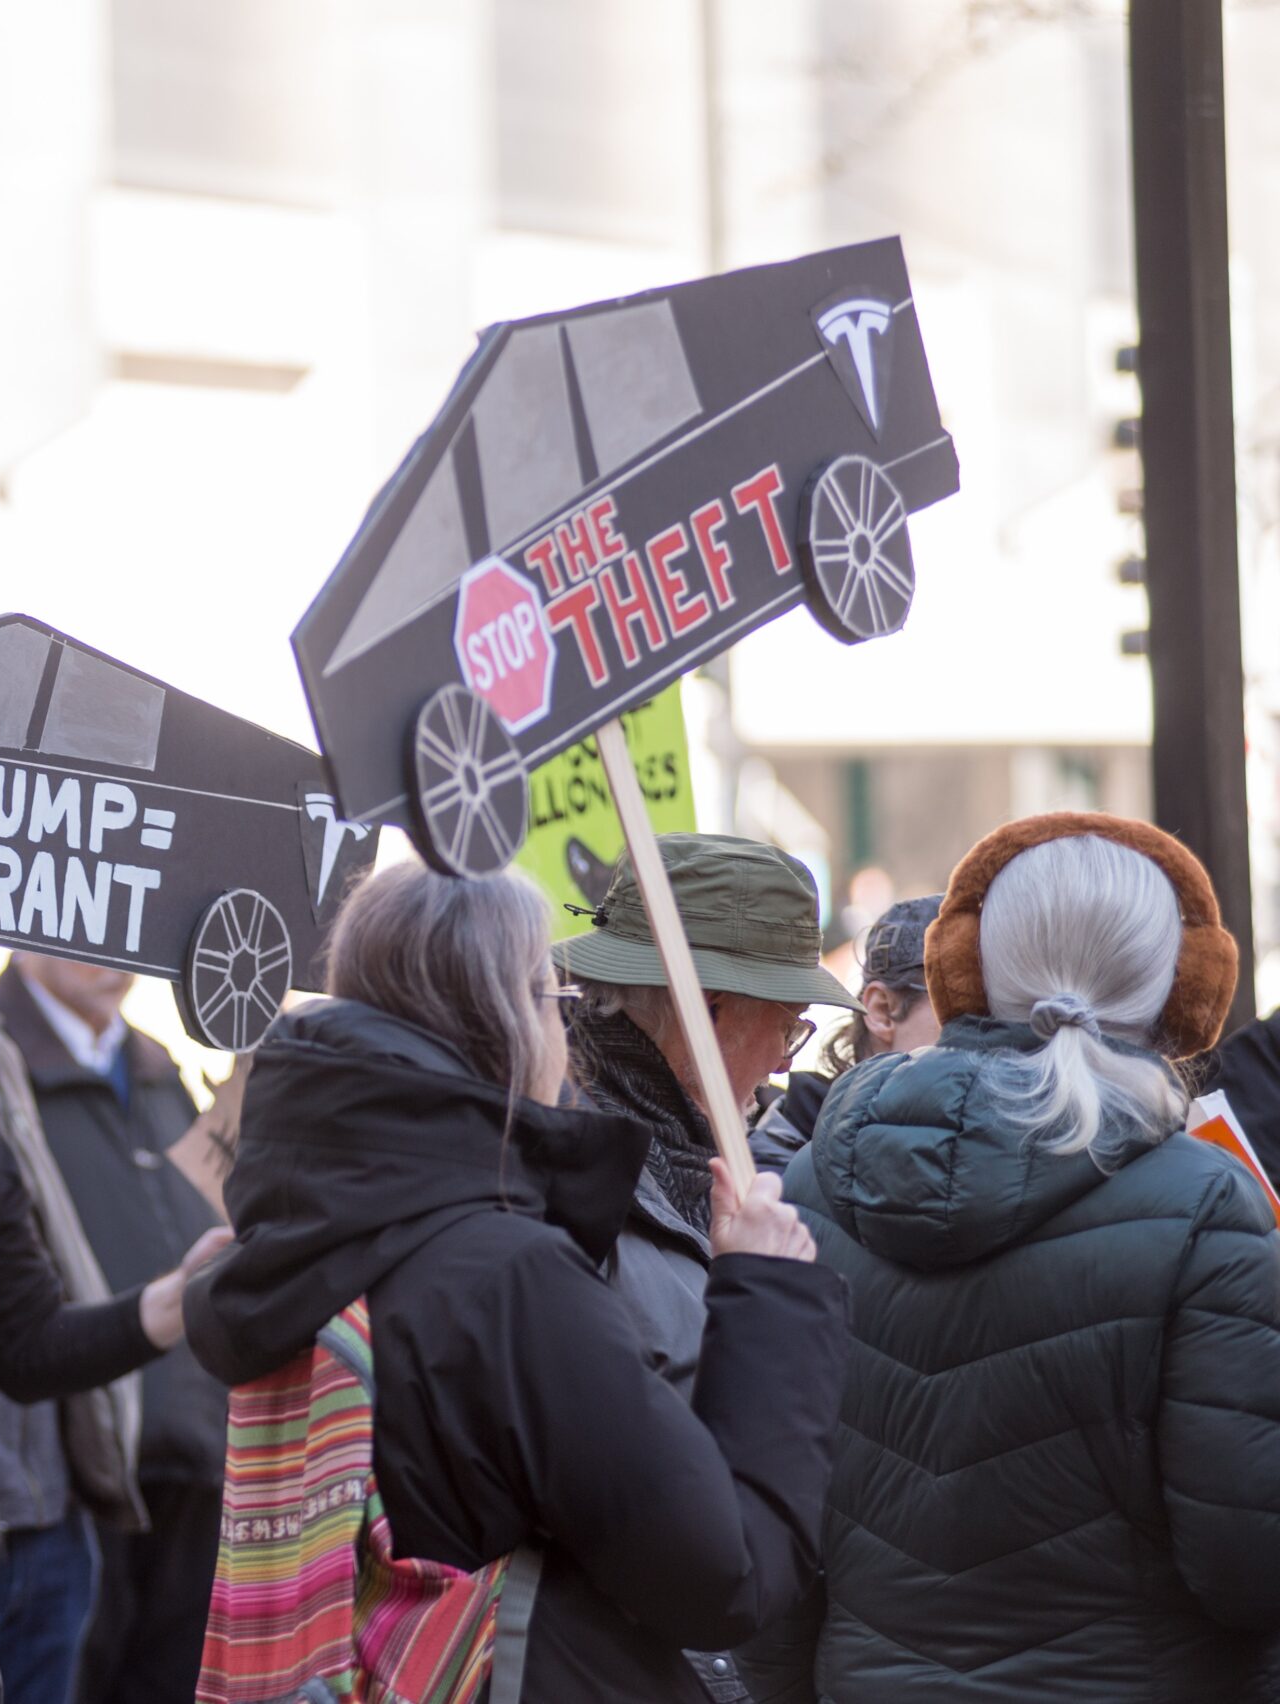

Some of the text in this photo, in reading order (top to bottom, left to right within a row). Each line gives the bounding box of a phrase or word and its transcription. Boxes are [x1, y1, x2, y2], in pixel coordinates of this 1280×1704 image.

[523, 494, 629, 598] THE
[542, 462, 793, 689] THEFT
[466, 601, 537, 692] STOP
